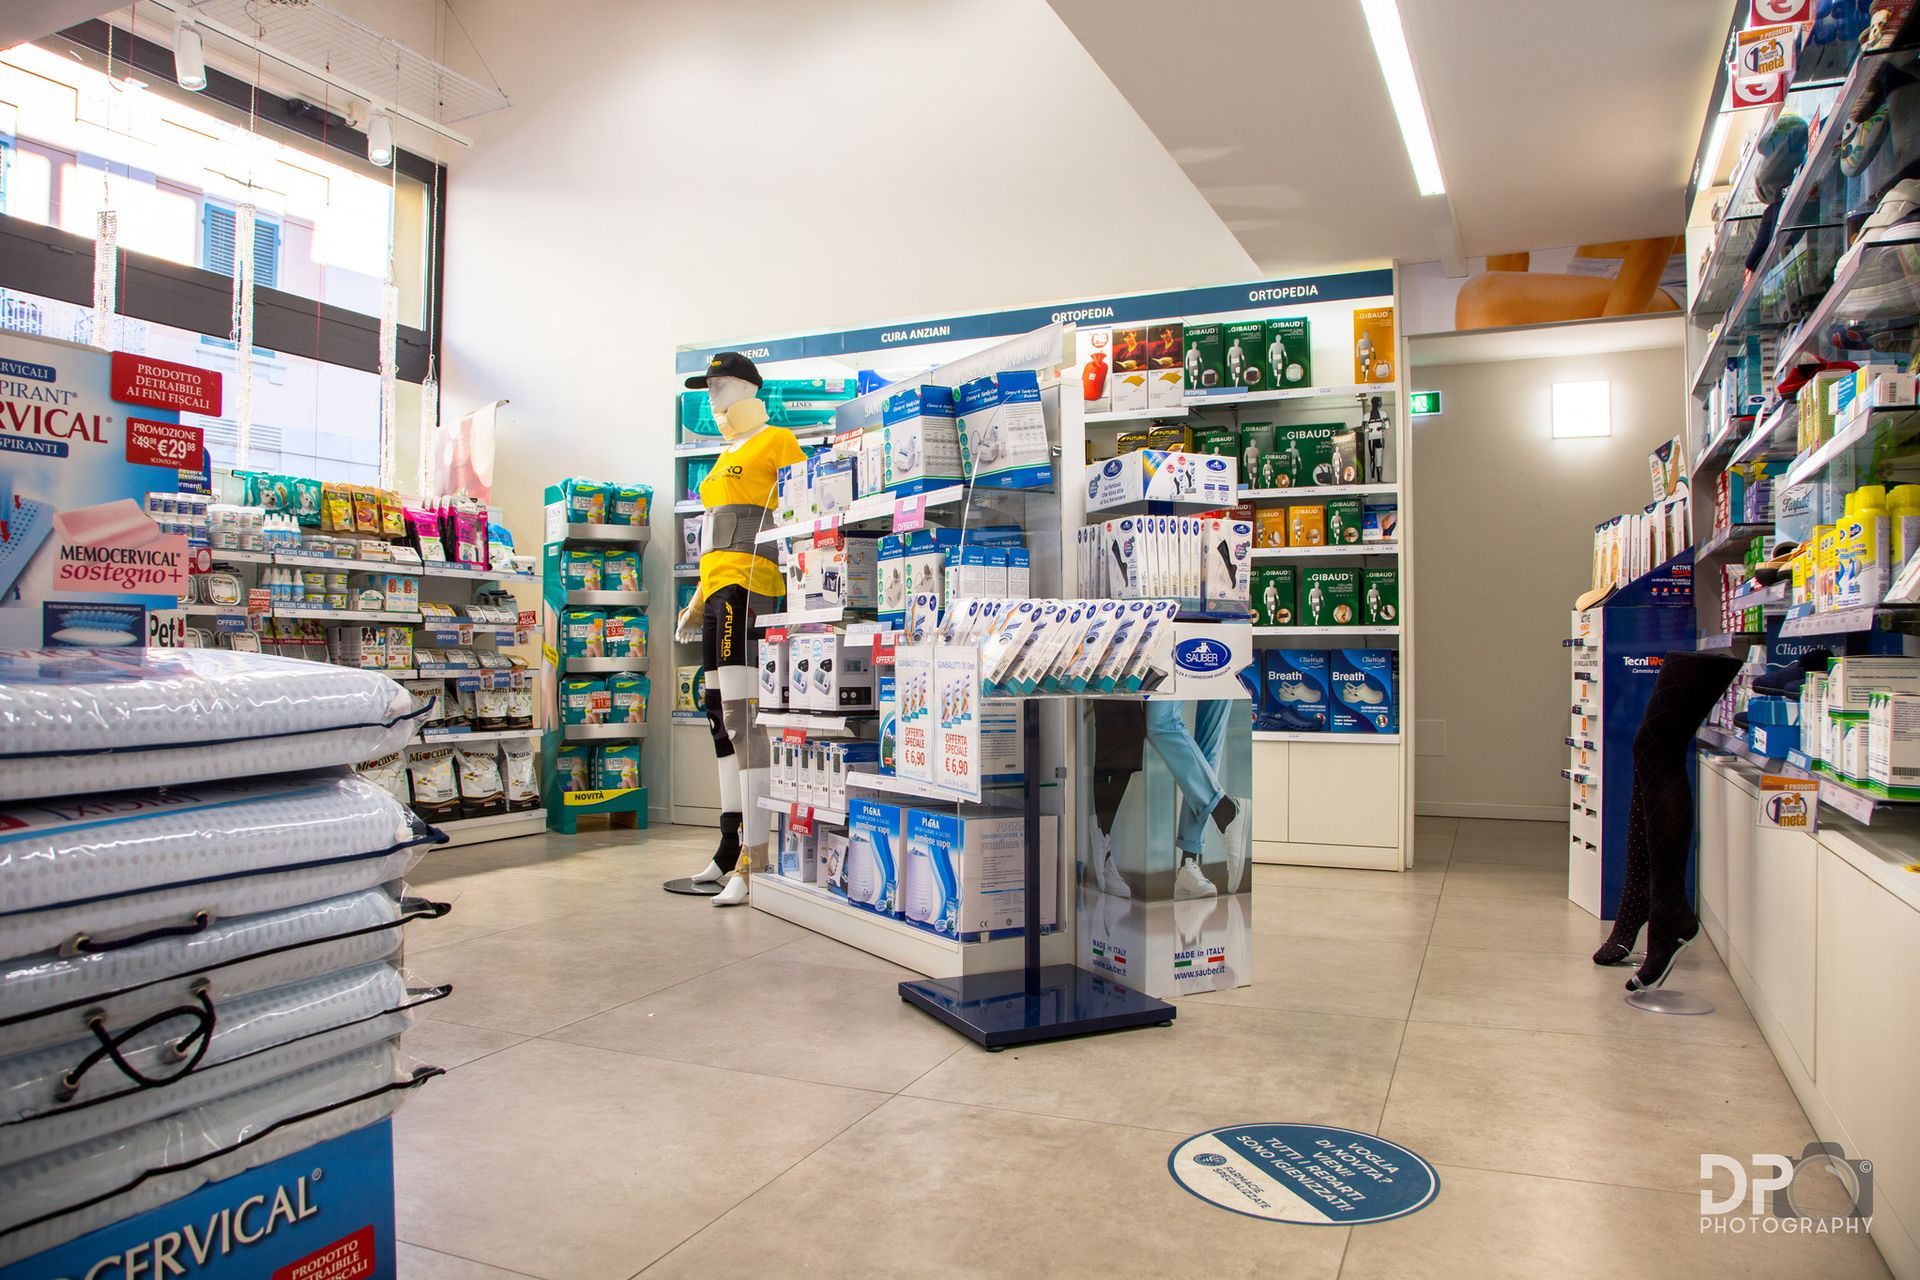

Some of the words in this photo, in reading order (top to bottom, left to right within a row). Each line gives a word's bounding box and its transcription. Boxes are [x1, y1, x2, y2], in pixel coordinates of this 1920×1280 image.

[1249, 285, 1319, 302] ORTOPEDIA
[1052, 306, 1114, 323] ORTOPEDIA
[1359, 311, 1388, 320] GIBAUD
[1272, 321, 1301, 329] GIBAUD
[881, 331, 908, 343] CURA
[909, 326, 951, 340] ANZIANI
[1189, 328, 1215, 336] GIBAUD
[0, 361, 49, 379] RVICALI
[138, 364, 201, 384] PRODOTTO
[136, 375, 202, 396] DETRAIBILE
[126, 386, 140, 396] AI
[142, 388, 166, 401] FINI
[168, 392, 210, 409] FISCALI
[134, 423, 197, 440] PROMOZIONE
[1287, 429, 1330, 440] GIBAUD
[1294, 508, 1318, 516] GIBAUD
[817, 538, 834, 547] OFFERTA
[60, 562, 183, 589] sostegno+
[1312, 573, 1348, 581] GIBAUD
[217, 619, 245, 627] OFFERTA
[151, 615, 175, 648] Pet
[725, 614, 733, 658] FUTURO
[876, 656, 895, 664] OFFERTA
[1186, 653, 1218, 663] SAUBER
[1268, 671, 1303, 681] Breath
[1332, 671, 1365, 681] Breath
[905, 727, 924, 738] OFFERTA
[904, 738, 925, 748] SPECIALE
[945, 733, 968, 746] OFFERTA
[945, 744, 968, 757] SPECIALE
[910, 751, 925, 767] 6,90
[951, 759, 968, 777] 6,90
[574, 791, 604, 800] NOVITÀ
[863, 805, 881, 816] PIGNA
[792, 824, 808, 834] OFFERTA
[922, 817, 940, 829] PIGNA
[878, 826, 890, 835] vapo
[936, 838, 951, 849] vapo
[1093, 939, 1106, 950] MADE
[1112, 946, 1127, 957] ITALY
[1174, 950, 1195, 960] MADE
[1197, 949, 1204, 957] in
[1206, 947, 1225, 956] ITALY
[1093, 960, 1127, 977] www.sauber.it
[1174, 966, 1225, 980] www.sauber.it
[1315, 1139, 1337, 1148] DI
[1312, 1151, 1356, 1177] VIENI!
[1347, 1142, 1400, 1174] VOGLIA
[1236, 1135, 1276, 1159] SONO
[1271, 1159, 1355, 1212] IGIENIZZATI!
[1265, 1137, 1304, 1161] TUTTI
[1305, 1164, 1366, 1201] REPARTI
[1223, 1166, 1264, 1194] FARMACIE
[1212, 1168, 1271, 1210] SPECIALIZZATE
[291, 1240, 359, 1280] PRODOTTO
